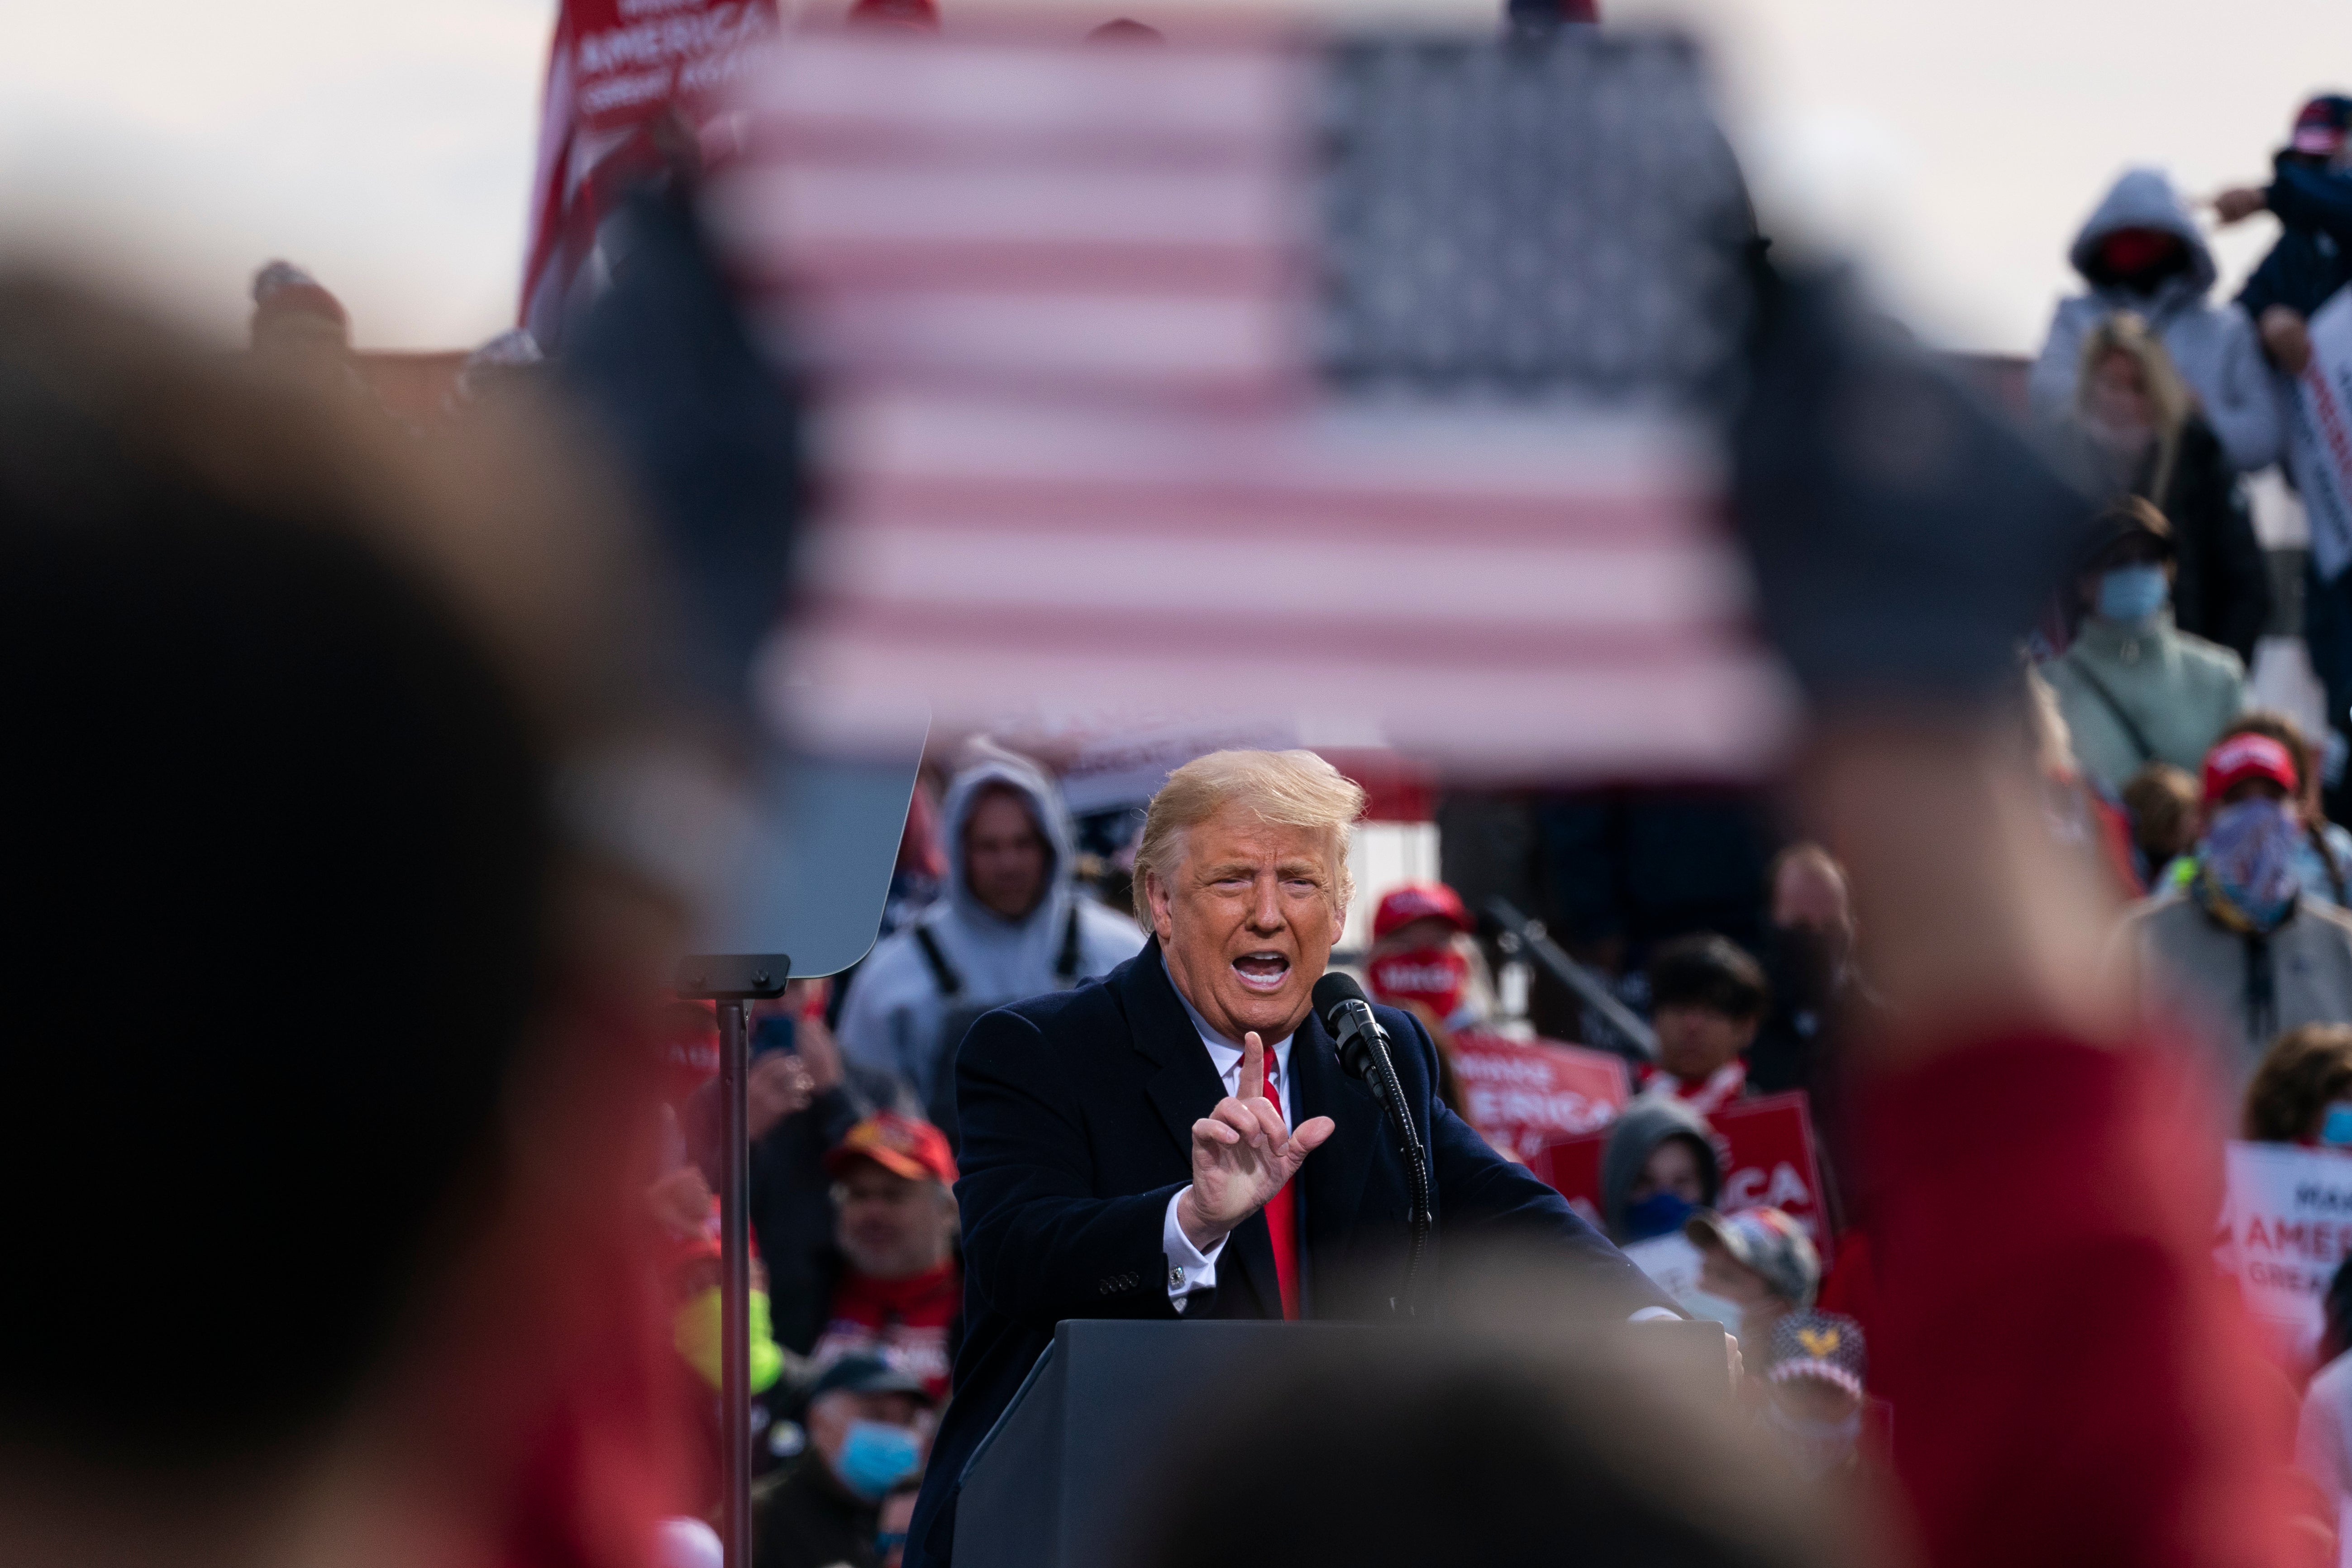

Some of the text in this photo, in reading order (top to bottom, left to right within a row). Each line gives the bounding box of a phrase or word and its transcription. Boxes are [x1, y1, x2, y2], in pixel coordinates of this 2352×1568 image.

[579, 2, 766, 71] AMERICA
[1466, 1084, 1617, 1134] ERICA
[2248, 1261, 2323, 1296] GREA
